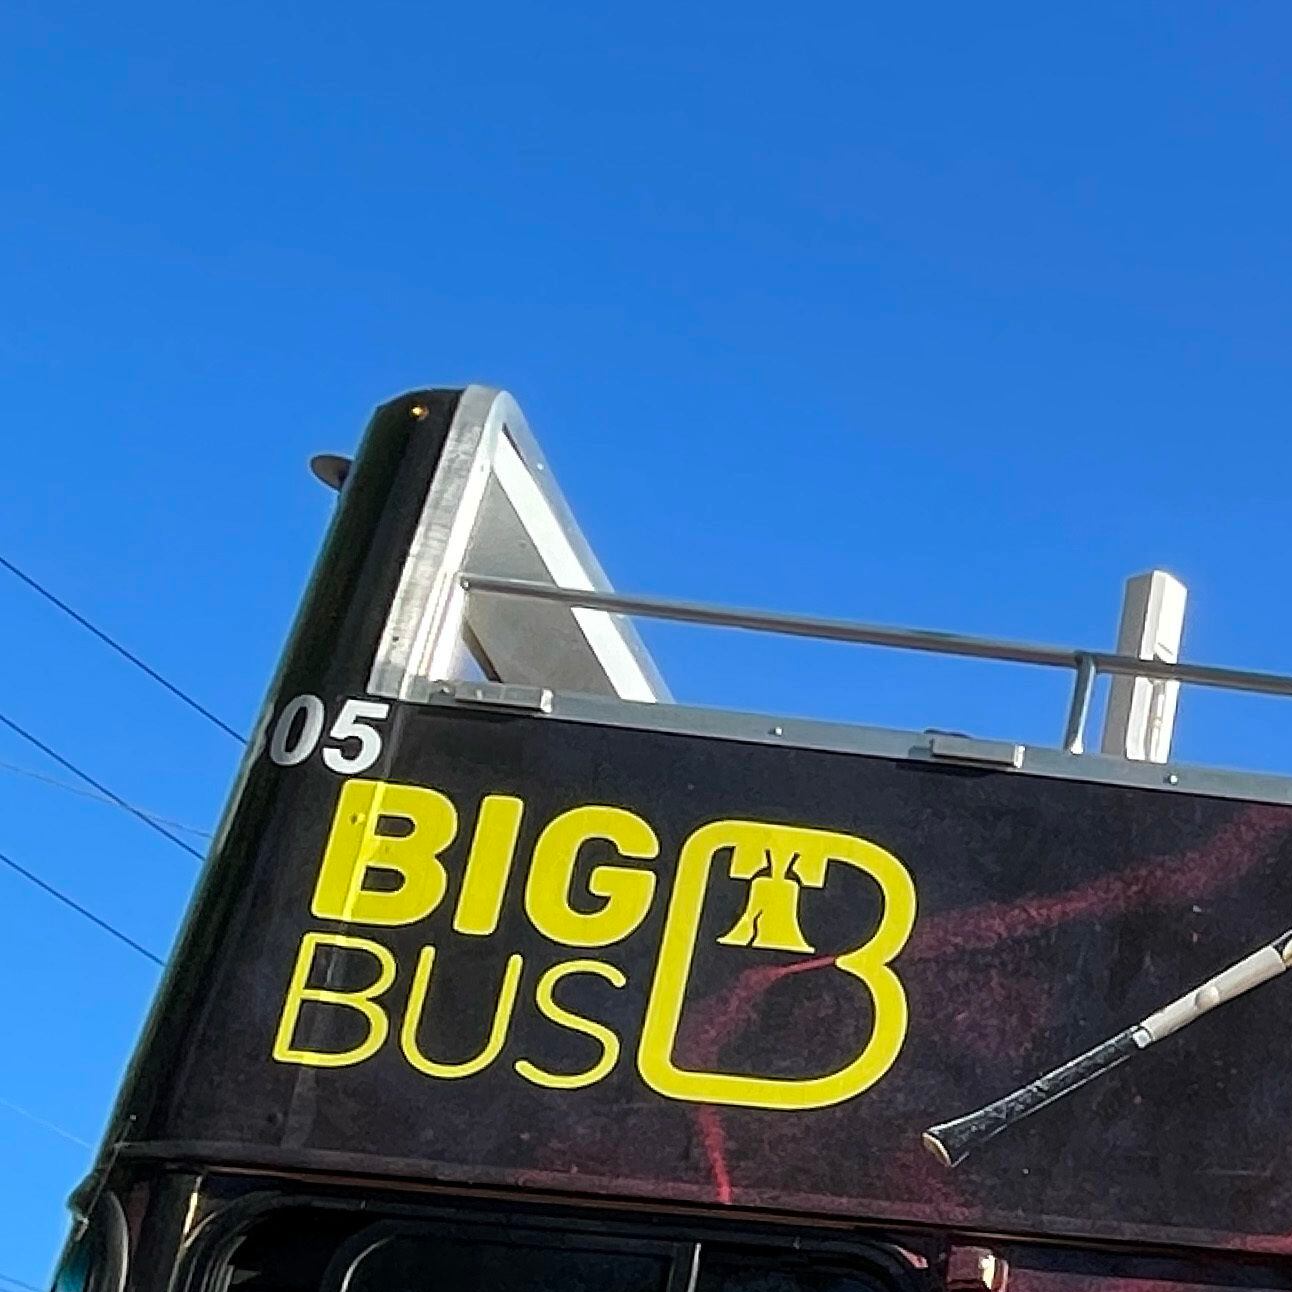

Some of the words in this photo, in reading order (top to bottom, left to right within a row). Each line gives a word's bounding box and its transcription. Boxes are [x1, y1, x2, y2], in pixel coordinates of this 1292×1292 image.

[270, 694, 390, 775] 05
[311, 778, 661, 947] BIG
[272, 932, 626, 1089] BUS
